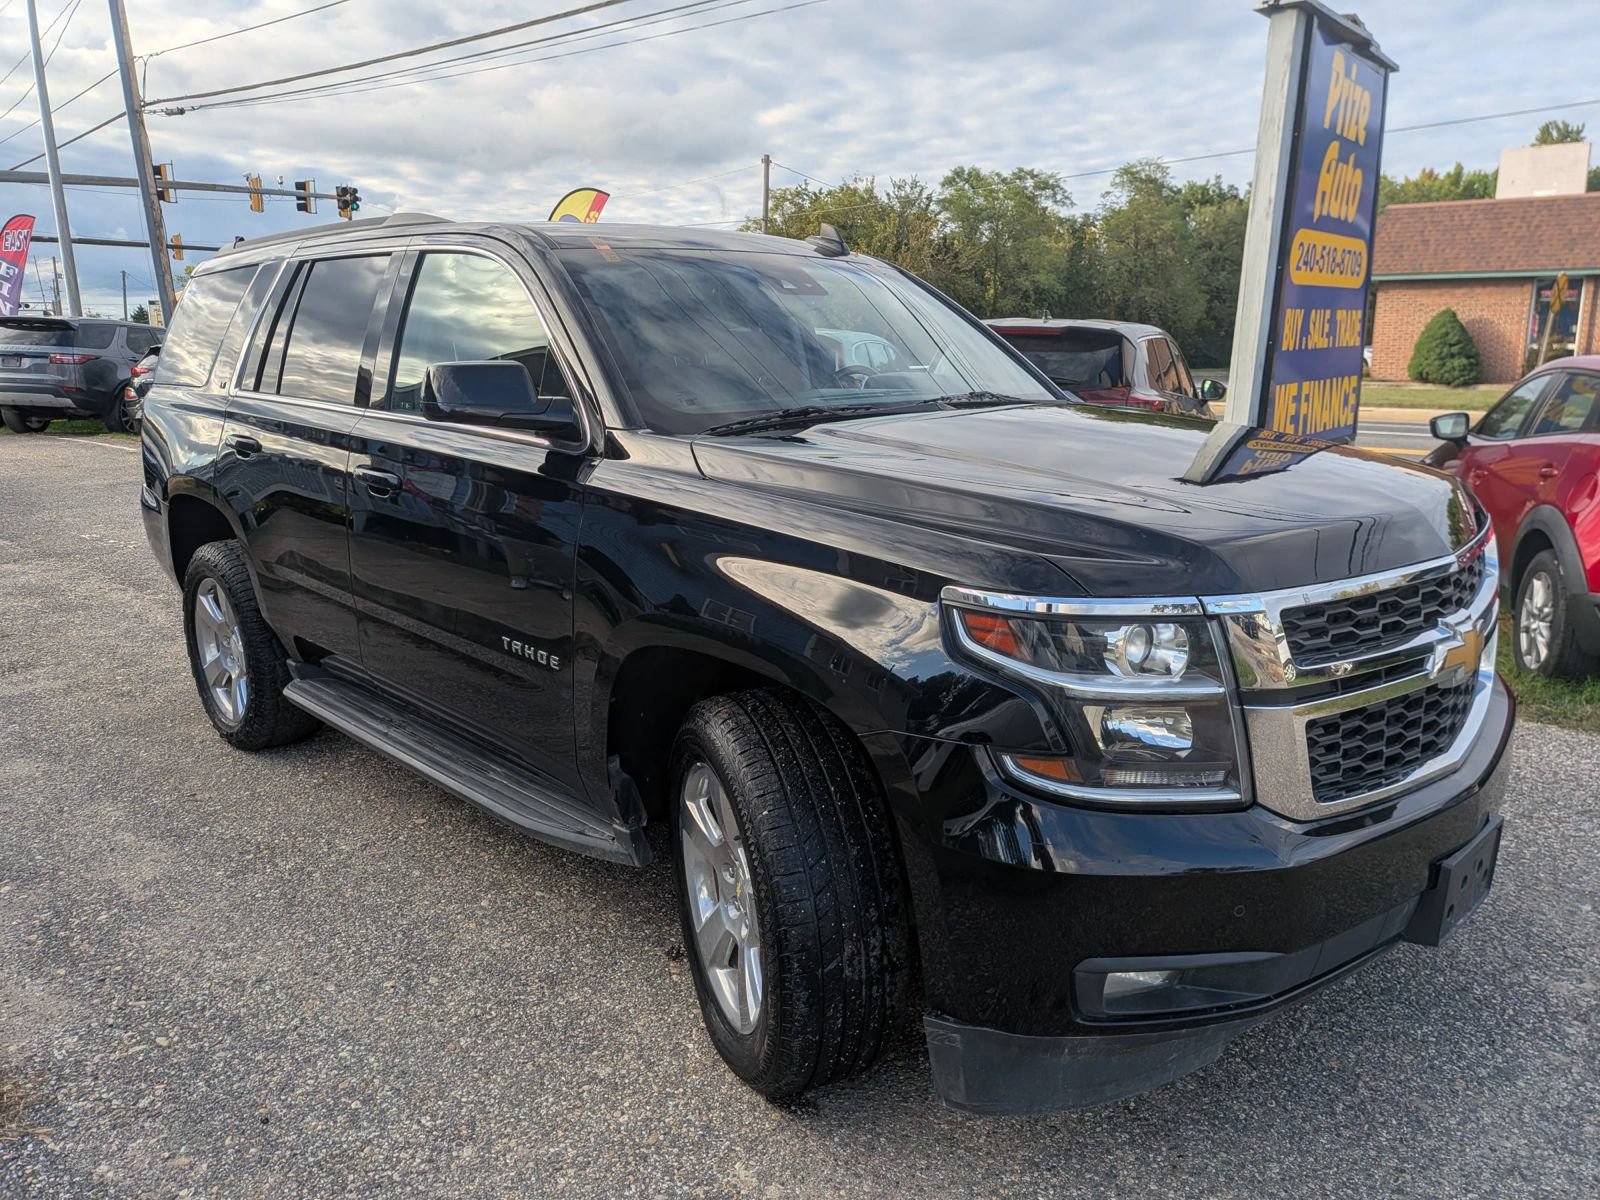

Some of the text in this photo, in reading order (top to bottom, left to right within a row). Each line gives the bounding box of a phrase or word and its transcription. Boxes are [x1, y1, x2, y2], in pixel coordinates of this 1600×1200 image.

[1323, 49, 1371, 146] Prize
[1313, 140, 1363, 224] Auto
[3, 229, 31, 252] EASY
[1295, 241, 1362, 277] 240-518-8709
[1282, 308, 1304, 351] BUY
[1308, 309, 1331, 350] SALE
[1335, 309, 1362, 348] TRADE
[1273, 375, 1358, 436] WE FINANCE
[502, 636, 559, 671] TAHOE
